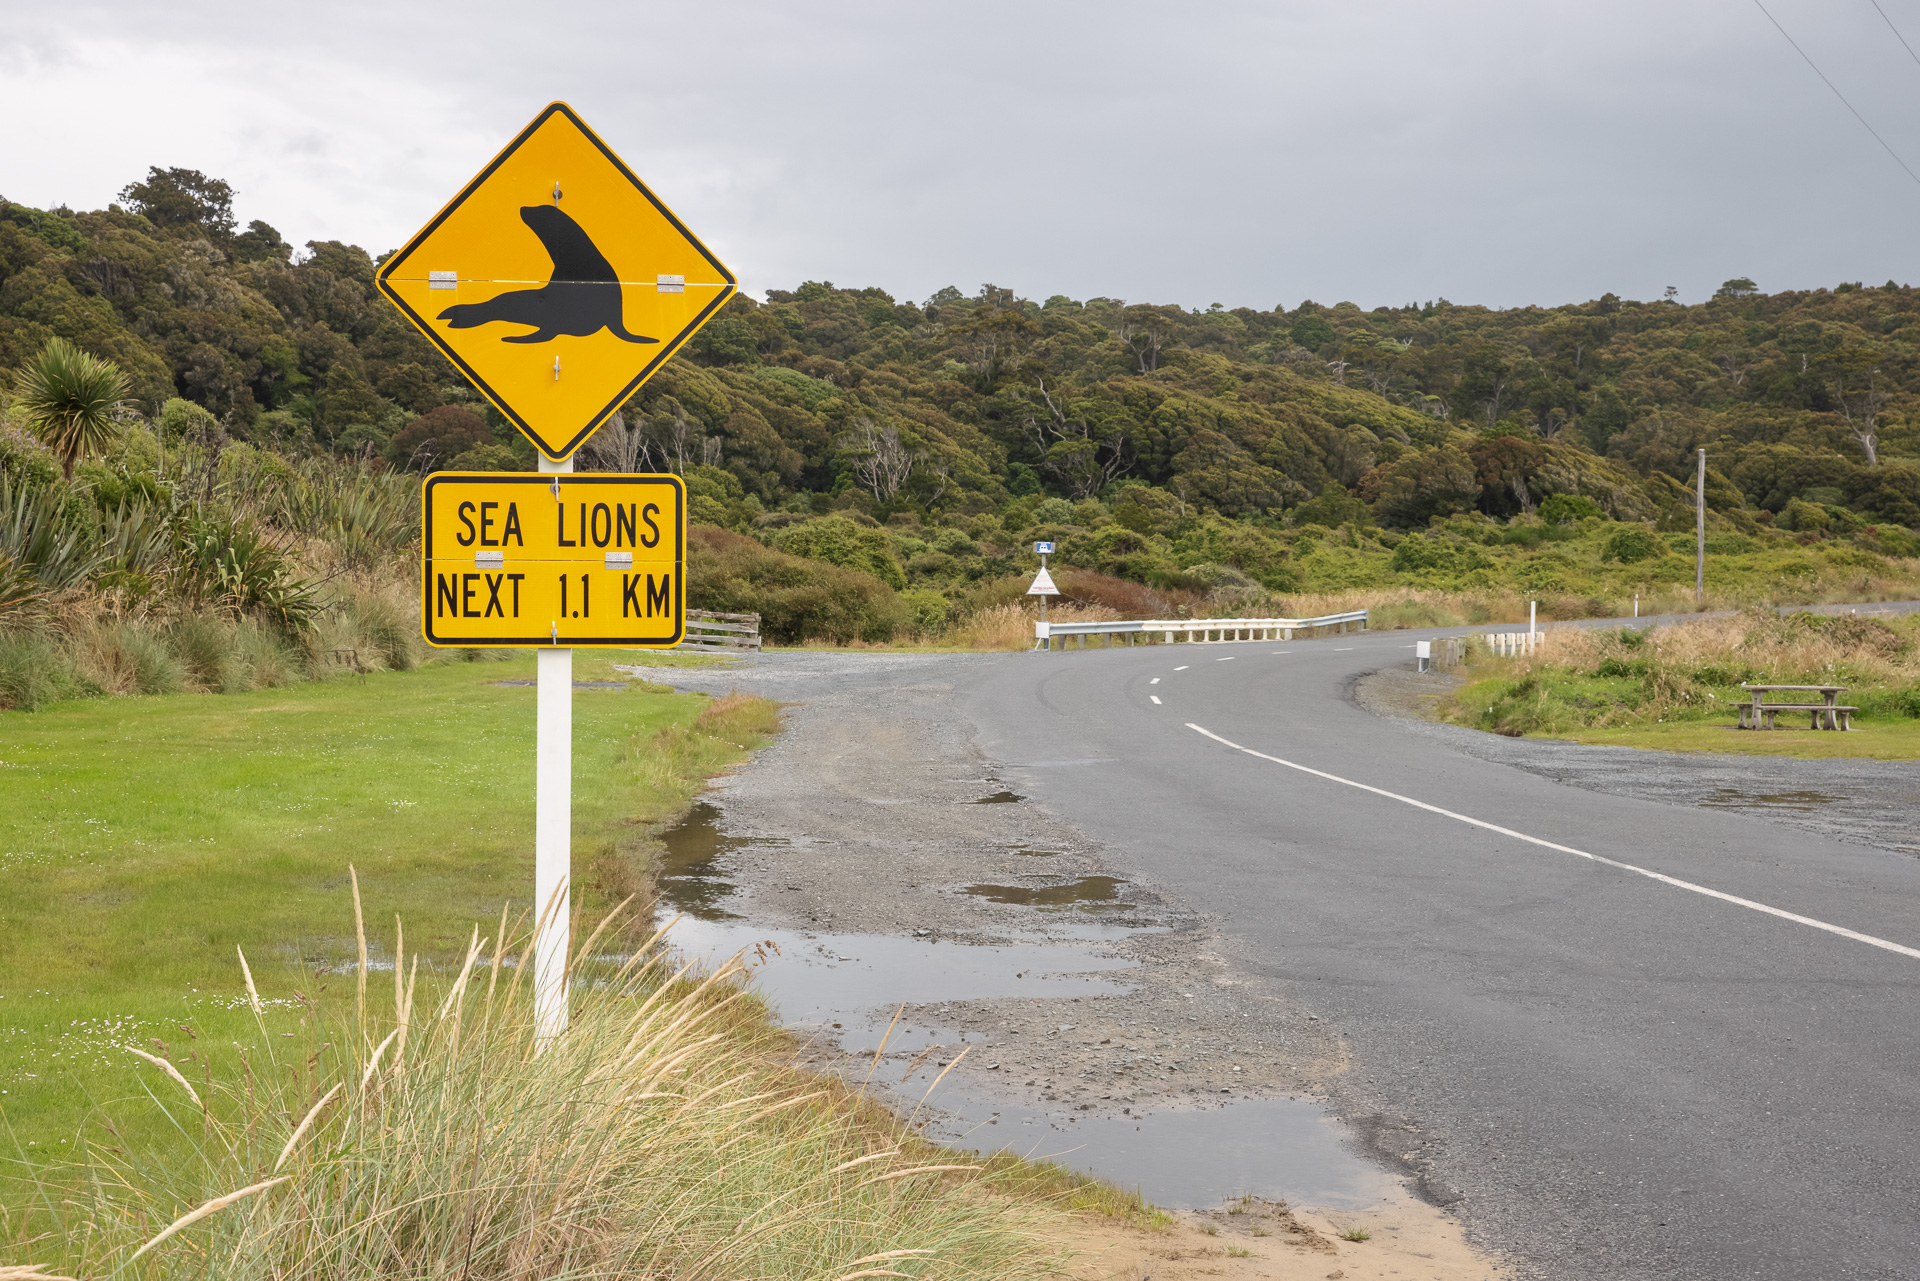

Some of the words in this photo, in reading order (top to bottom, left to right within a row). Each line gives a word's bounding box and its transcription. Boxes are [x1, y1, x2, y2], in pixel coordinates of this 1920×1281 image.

[456, 501, 524, 547] SEA
[558, 502, 660, 549] LIONS
[437, 573, 525, 618] NEXT
[559, 573, 589, 618] 1.1
[623, 573, 670, 618] KM
